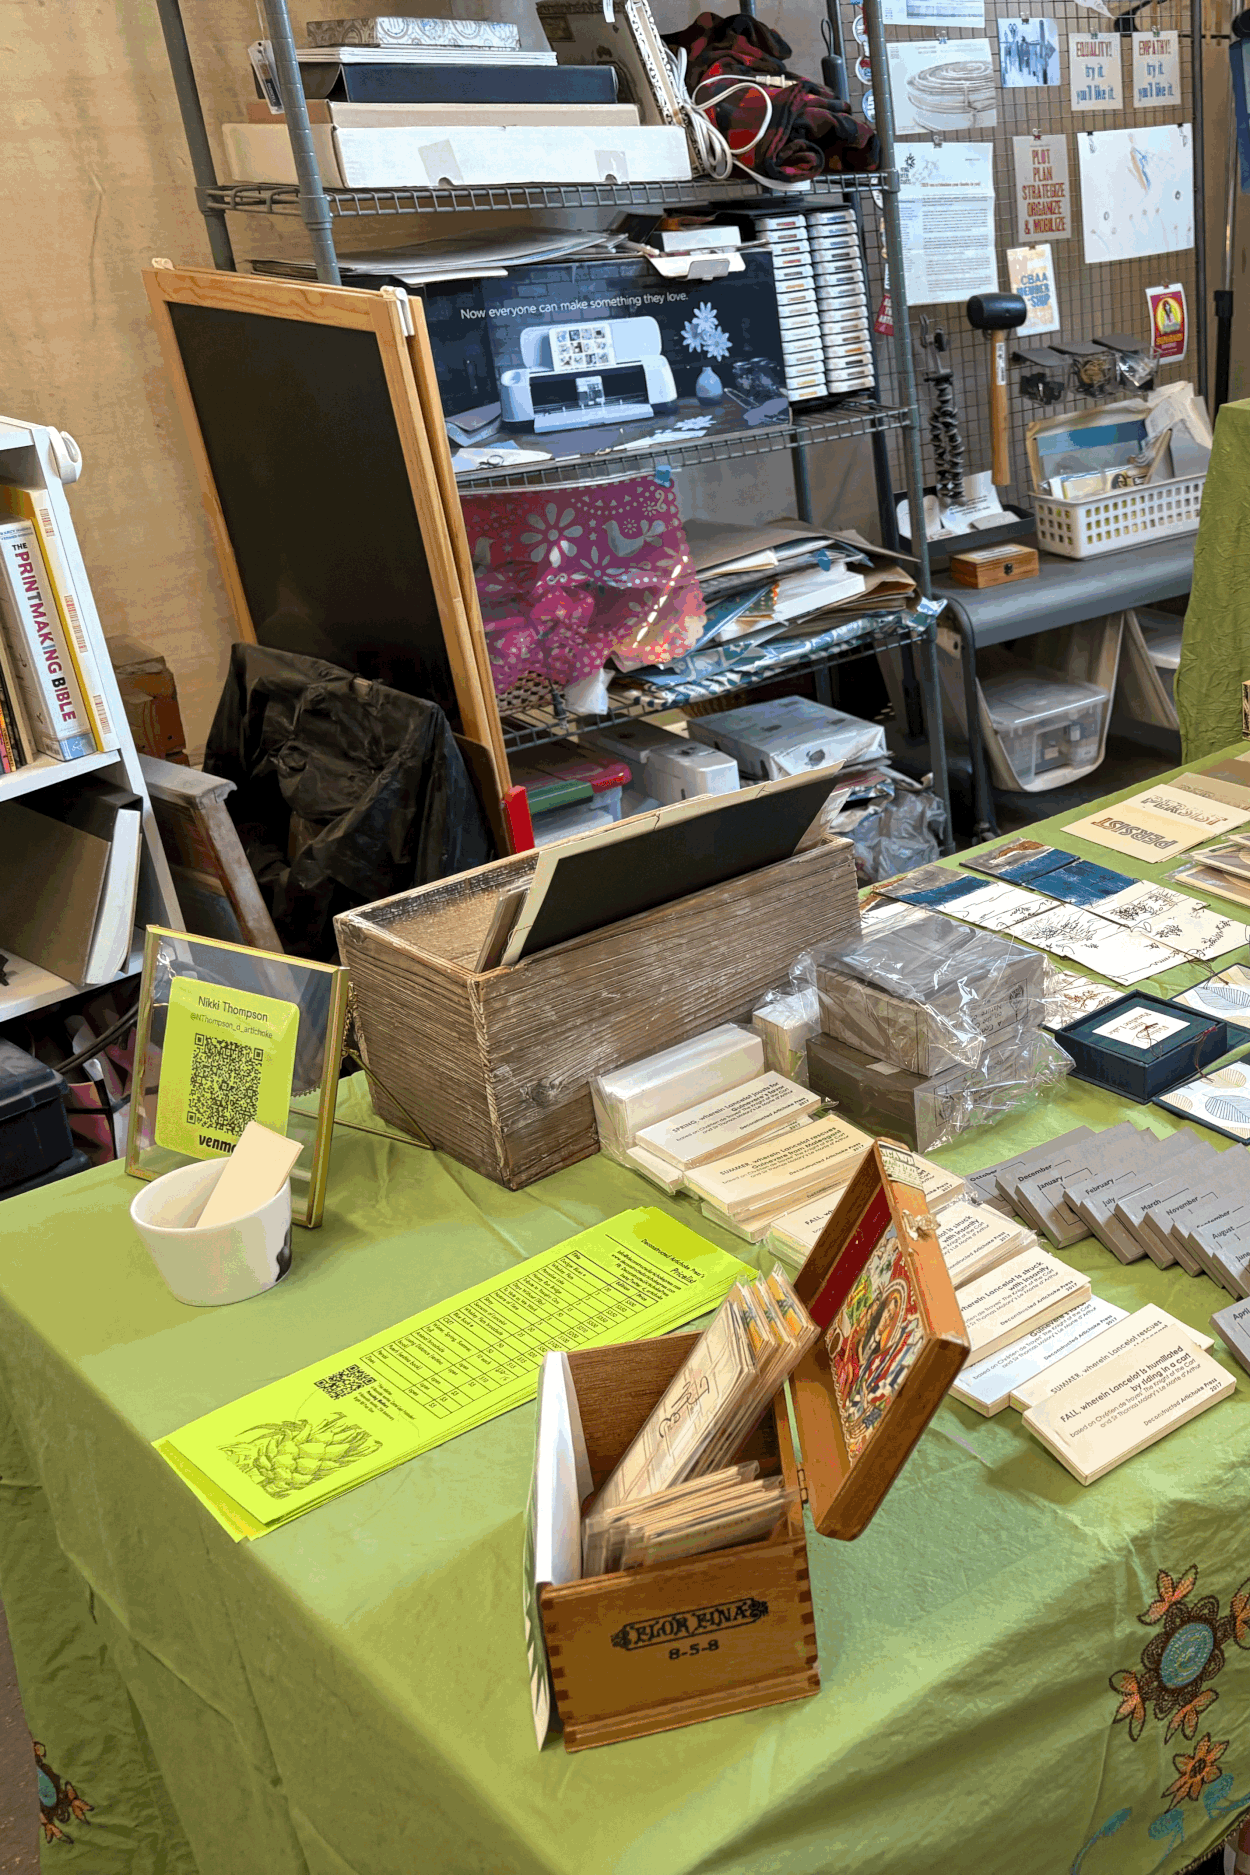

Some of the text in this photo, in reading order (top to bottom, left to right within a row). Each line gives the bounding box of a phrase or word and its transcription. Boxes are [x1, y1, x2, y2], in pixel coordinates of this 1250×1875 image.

[1032, 149, 1050, 165] PLOT
[1033, 166, 1053, 182] PLAN
[1022, 183, 1065, 200] STRATEGIZE
[1027, 200, 1062, 217] ORGANIZE
[1033, 216, 1066, 234] MOBILIZE
[1021, 272, 1048, 285] CBAA
[1017, 283, 1050, 296] MEMBER
[461, 291, 689, 320] Now everyone can make something they love.
[12, 542, 28, 551] THE
[15, 551, 62, 674] PRINTMAKING
[51, 676, 77, 723] BIBLE
[1091, 817, 1178, 849] PERSIST
[198, 996, 268, 1023] Nikki Thompson
[969, 1169, 998, 1182] October
[1017, 1164, 1052, 1182] December
[1036, 1175, 1064, 1191] January
[1085, 1178, 1115, 1194] February
[1102, 1196, 1116, 1207] July
[1141, 1198, 1162, 1212] March
[1166, 1196, 1199, 1216] November
[1212, 1226, 1235, 1240] August
[1235, 1252, 1250, 1262] June
[1232, 1308, 1250, 1321] April
[1050, 1320, 1162, 1395] SUMMER, wherein Lancelot rescues
[1130, 1382, 1142, 1392] by
[1142, 1370, 1163, 1386] riding
[1176, 1353, 1191, 1365] cart
[1060, 1410, 1081, 1422] FALL,
[1080, 1391, 1111, 1412] wherein
[1109, 1372, 1140, 1394] Lancelot
[1148, 1346, 1184, 1371] humiliated
[1210, 1383, 1223, 1392] 2017
[1143, 1378, 1218, 1426] Deconstructed Artichoke Press
[668, 1639, 719, 1660] 8-5-8
